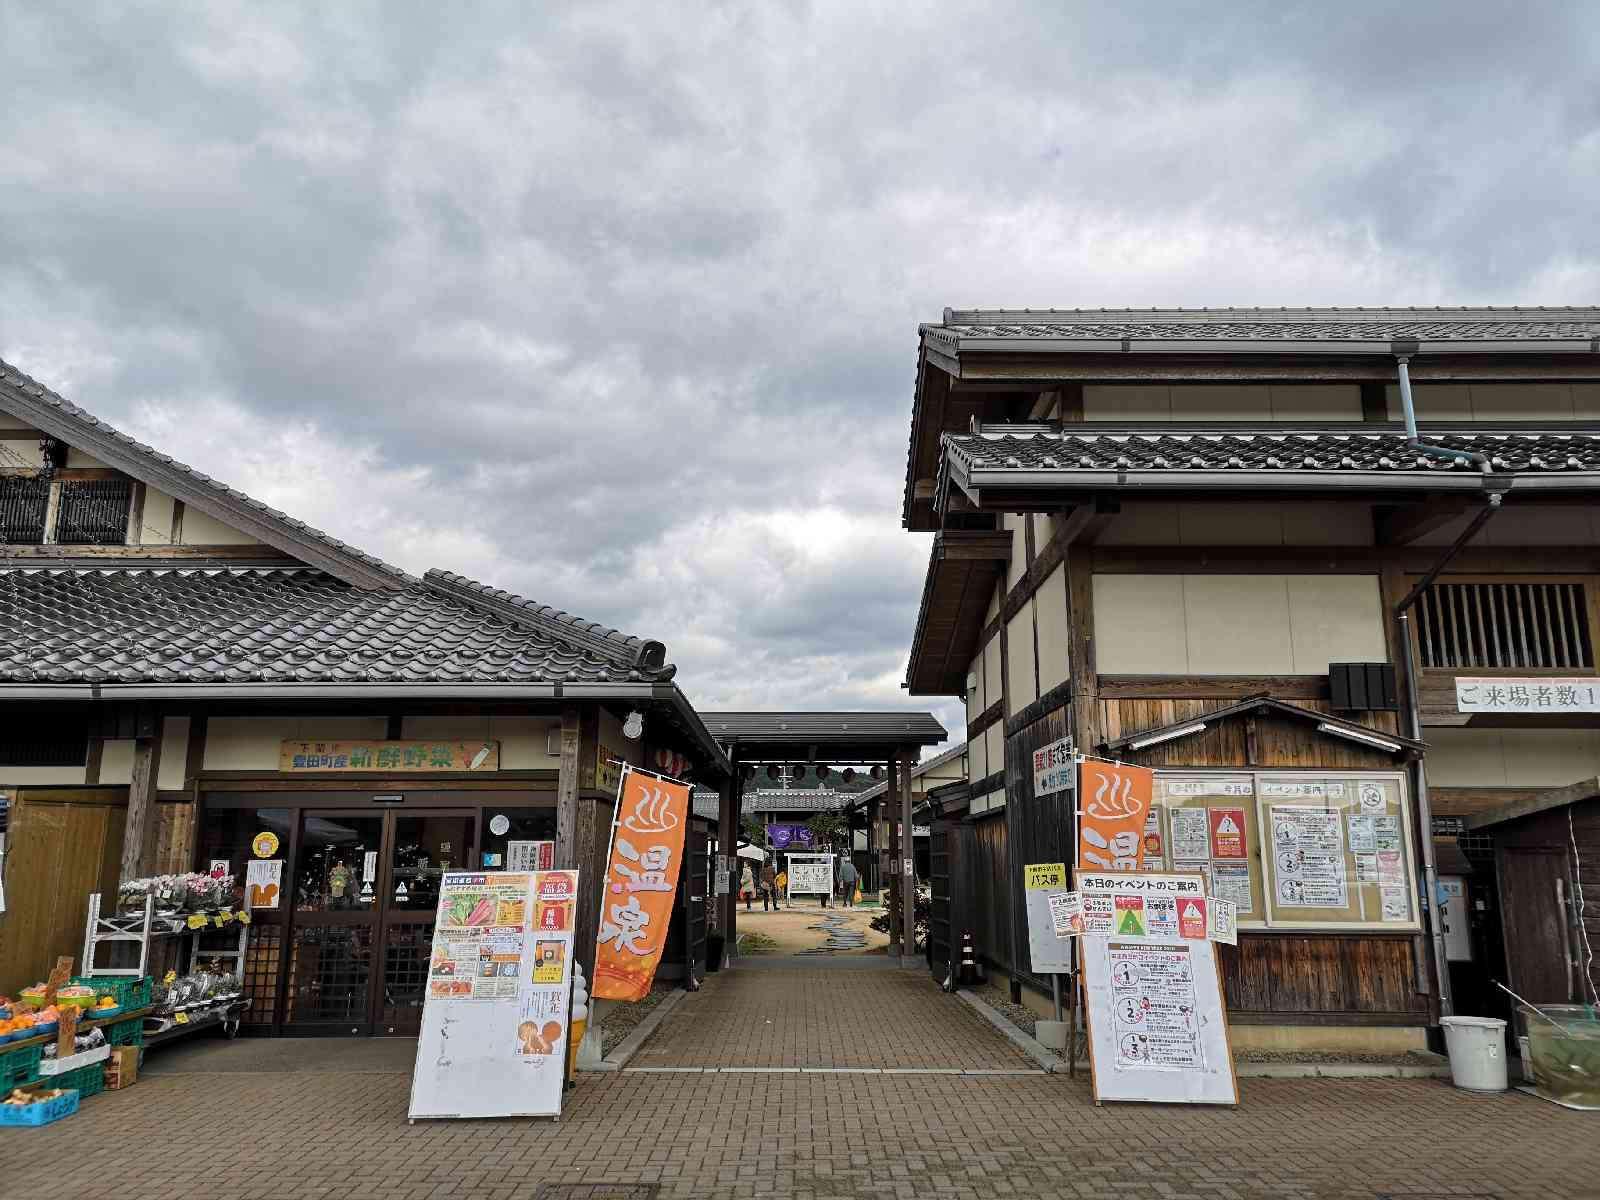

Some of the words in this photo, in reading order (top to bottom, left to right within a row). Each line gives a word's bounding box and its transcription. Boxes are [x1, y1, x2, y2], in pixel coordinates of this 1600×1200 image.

[350, 745, 454, 768] 新鮮野菜
[1031, 874, 1061, 886] バス停
[1084, 878, 1199, 892] 本日のイベントのご案内
[598, 838, 674, 957] 温泉
